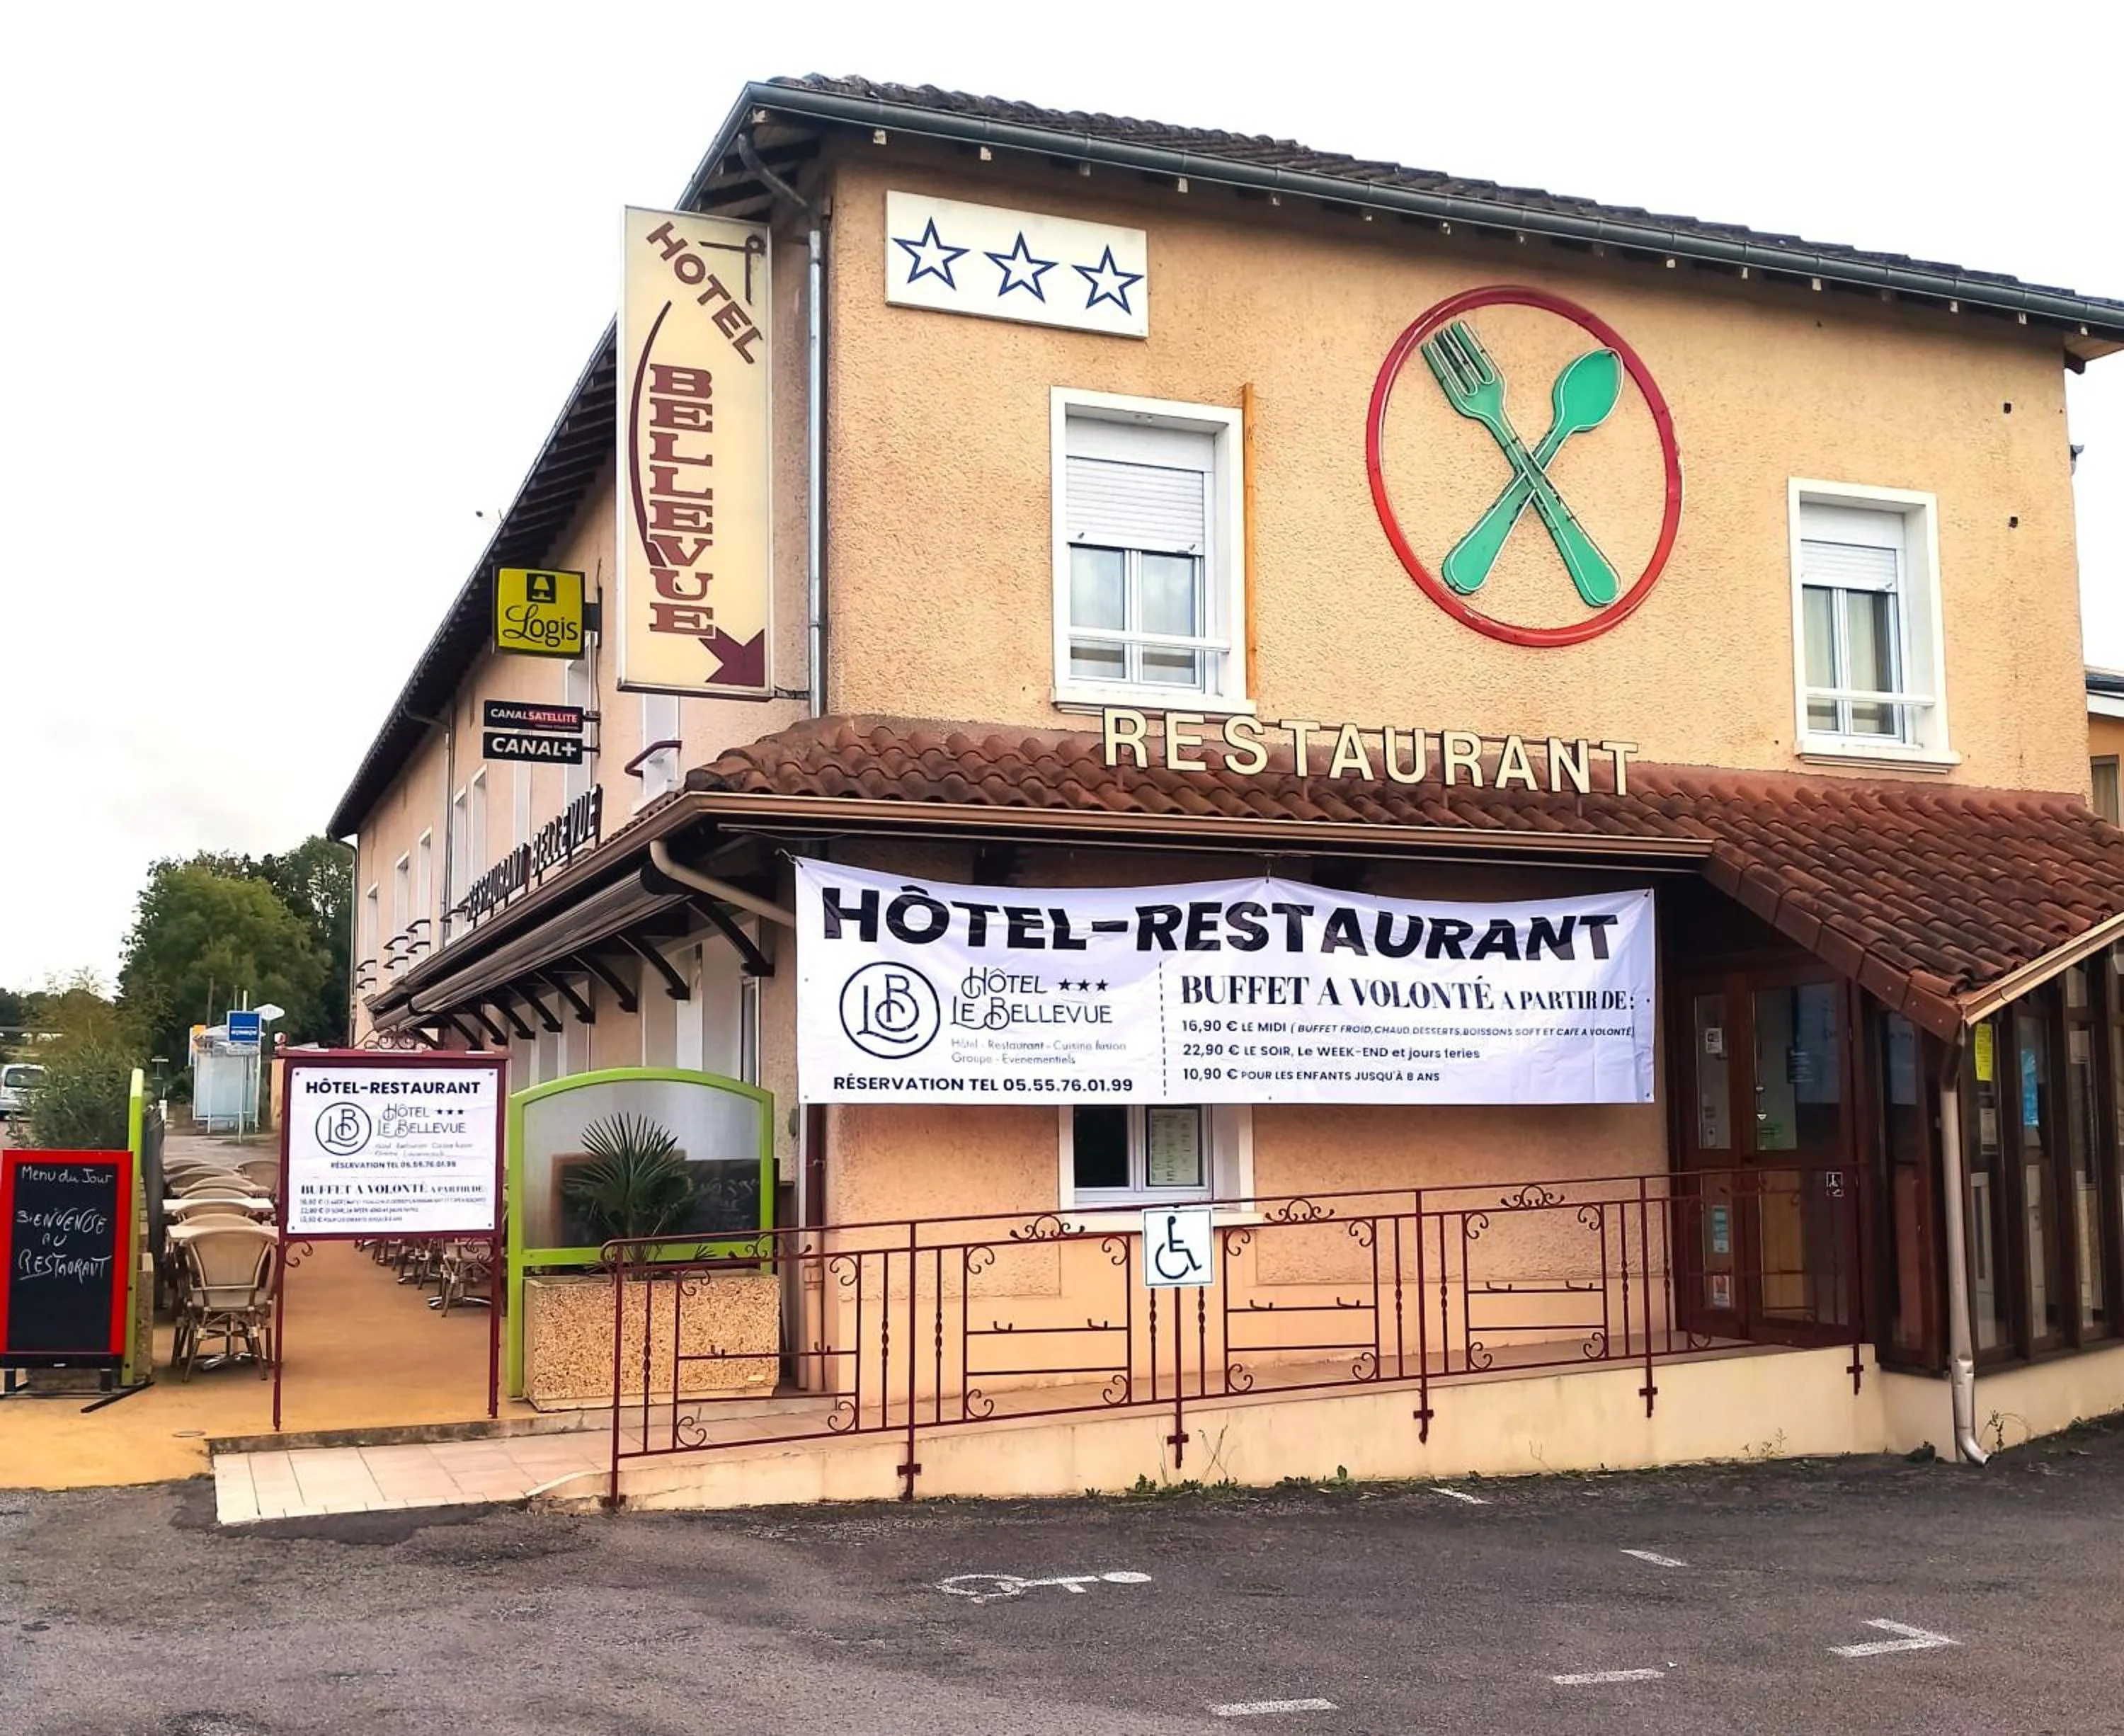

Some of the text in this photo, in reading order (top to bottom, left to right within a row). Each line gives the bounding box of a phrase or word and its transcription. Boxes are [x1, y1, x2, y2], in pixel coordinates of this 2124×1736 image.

[646, 221, 763, 364] HOTEL
[649, 363, 714, 638] BELLEVUE
[503, 604, 578, 647] Logis
[491, 709, 578, 723] CANALSATELLITE
[492, 737, 577, 757] CANAL+
[1102, 707, 1639, 796] RESTAURANT
[822, 884, 1619, 961] HÔTEL-RESTAURANT
[1181, 976, 1309, 1005] BUFFET
[1317, 977, 1342, 1005] A
[1349, 975, 1494, 1009] VOLONTÉ
[1500, 991, 1515, 1010] A
[1520, 990, 1597, 1010] PARTIR
[1182, 1020, 1221, 1033] 16,90
[1226, 1021, 1238, 1032] €
[1242, 1022, 1253, 1032] LE
[1258, 1022, 1286, 1032] MIDI
[988, 1039, 1044, 1050] Restaurant
[1182, 1044, 1223, 1058] 22,90
[1228, 1044, 1239, 1055] €
[1244, 1046, 1256, 1056] LE
[1261, 1046, 1294, 1057] SOIR,
[1298, 1046, 1313, 1056] Le
[1318, 1046, 1388, 1057] WEEK-END
[1392, 1048, 1405, 1057] et
[1408, 1048, 1441, 1061] jours
[833, 1073, 1133, 1092] RÉSERVATION TEL 05.55.76.01.99
[1184, 1068, 1221, 1081] 10,90
[1227, 1068, 1238, 1080] €
[1241, 1070, 1272, 1080] POUR
[1275, 1071, 1294, 1080] LES
[1296, 1071, 1351, 1080] ENFANTS
[1417, 1073, 1439, 1081] ANS
[306, 1078, 481, 1094] HÔTEL-RESTAURANT
[22, 1165, 113, 1183] Menu du Jour
[42, 1233, 67, 1247] AU
